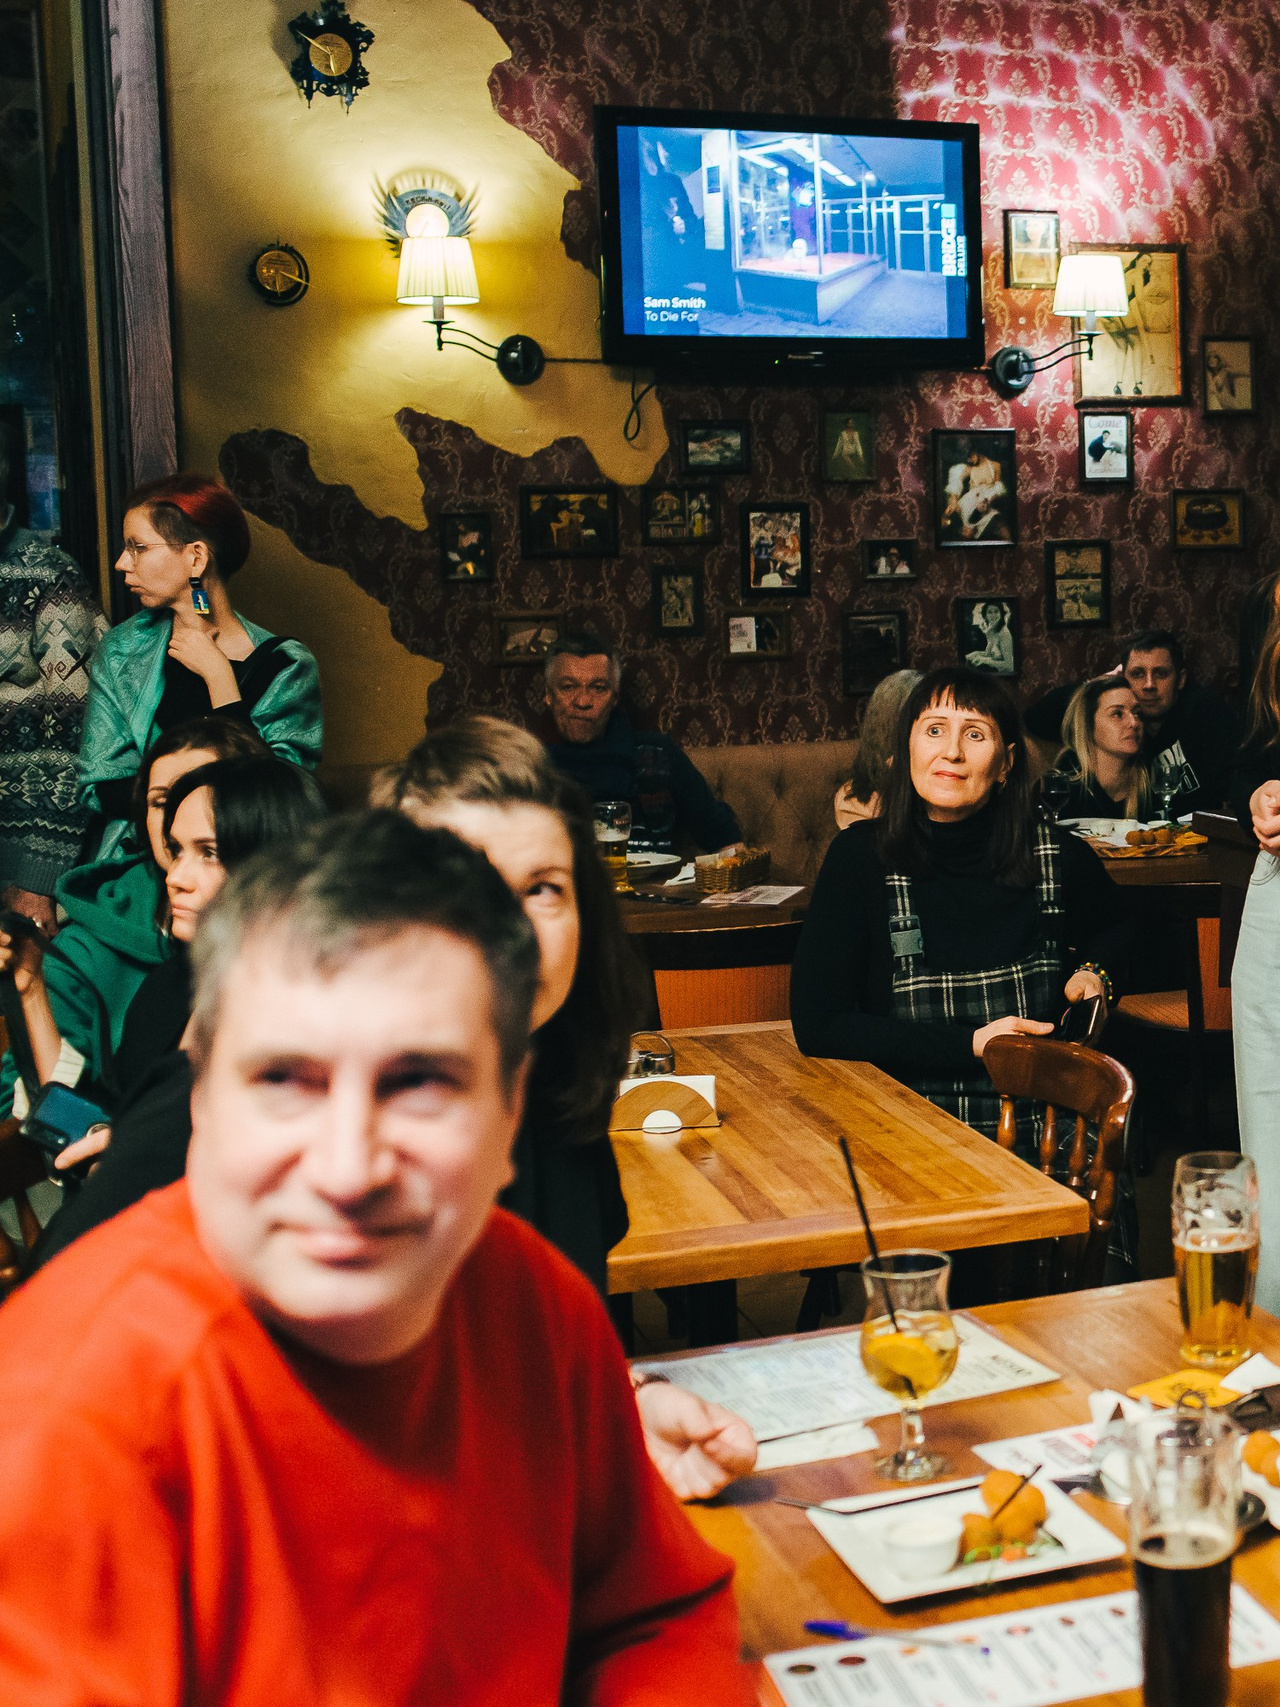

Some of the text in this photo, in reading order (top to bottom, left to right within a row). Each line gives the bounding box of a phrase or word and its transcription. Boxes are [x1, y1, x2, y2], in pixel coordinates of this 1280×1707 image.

[957, 236, 967, 277] DELUXE
[643, 296, 707, 309] Sam Smith
[644, 310, 699, 322] To Die For
